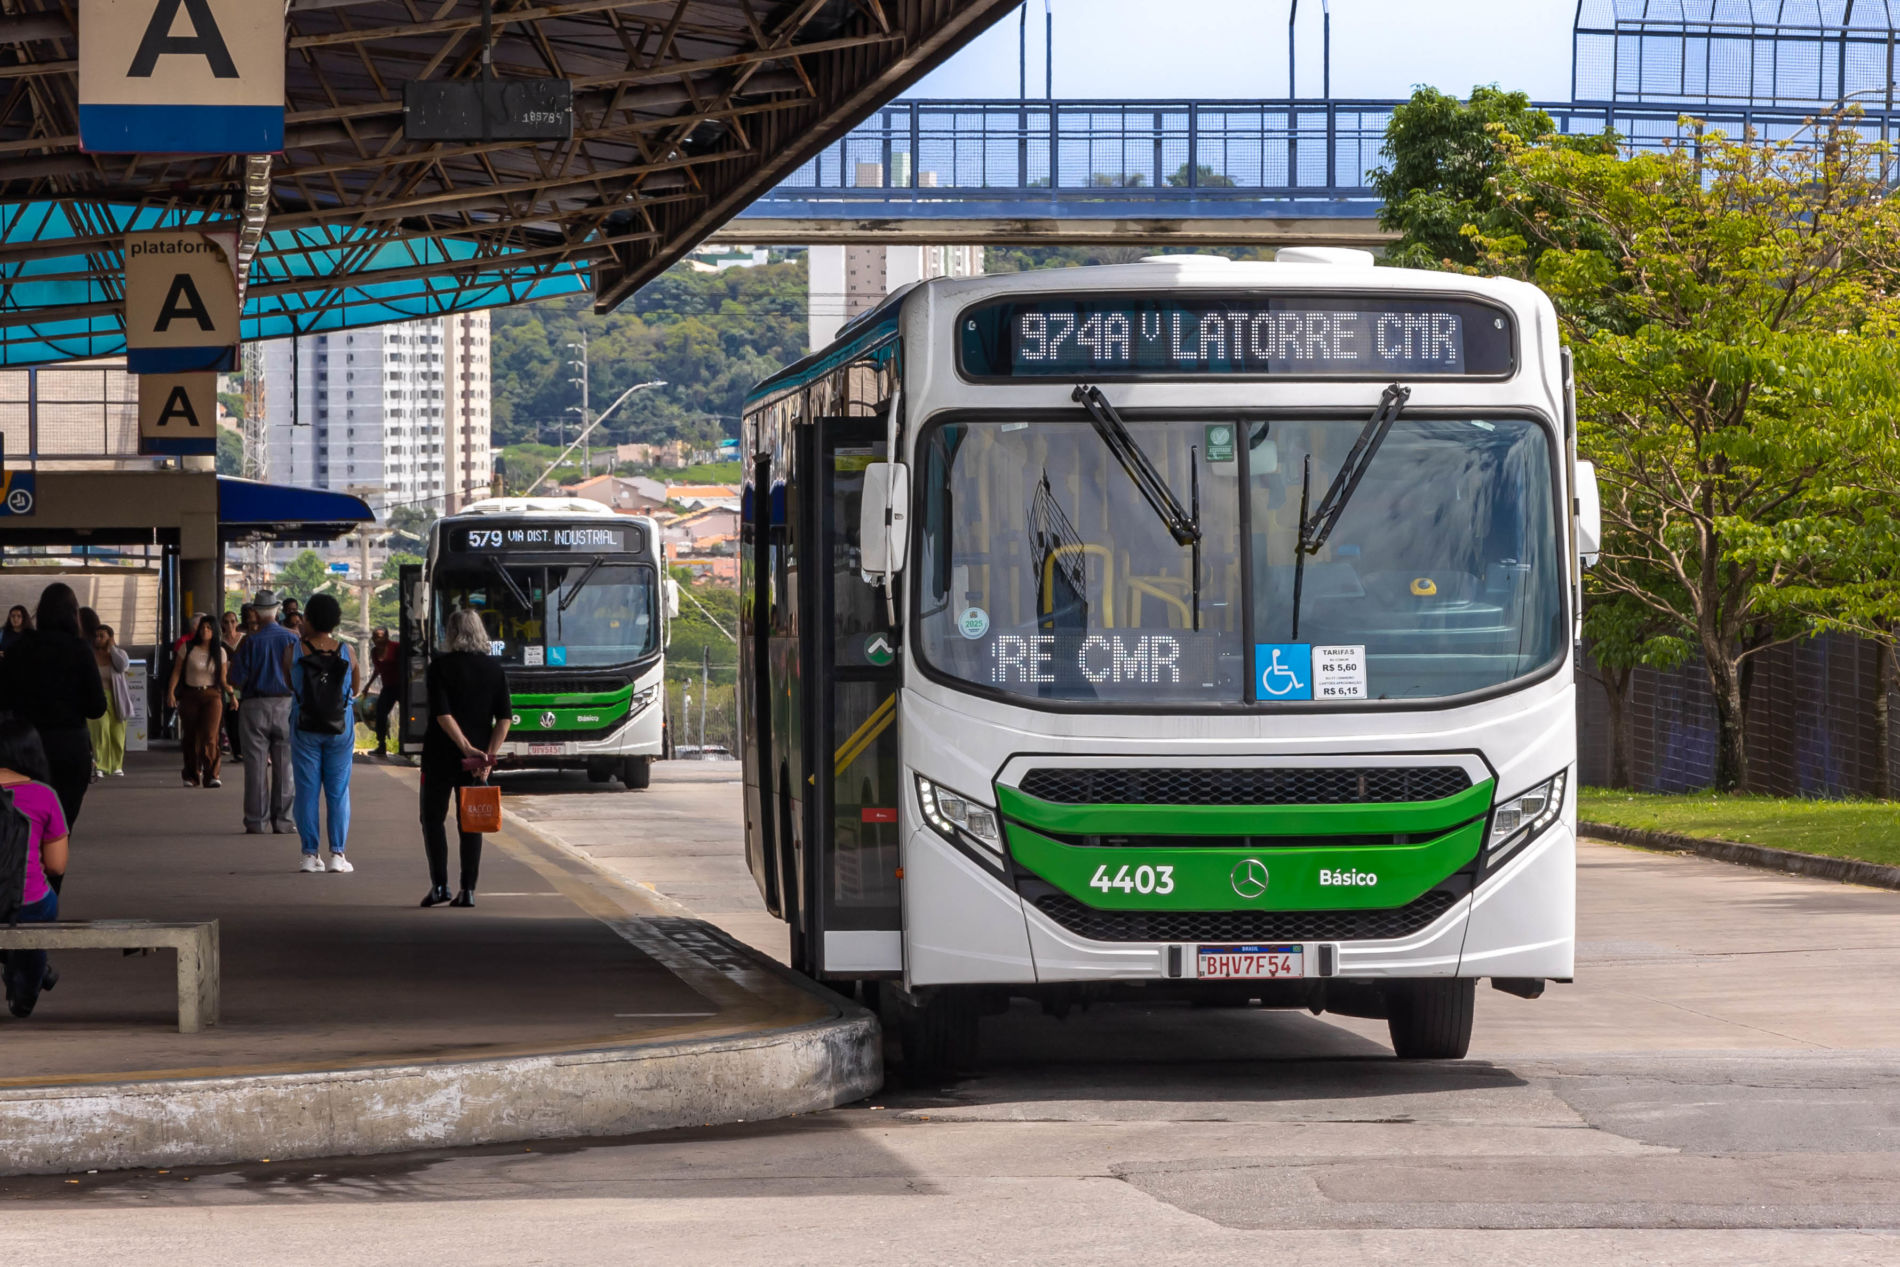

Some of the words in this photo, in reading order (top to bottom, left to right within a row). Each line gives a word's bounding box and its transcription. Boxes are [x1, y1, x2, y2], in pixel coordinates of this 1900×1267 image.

[127, 0, 240, 78] A
[153, 273, 216, 332] A
[1021, 312, 1129, 360] 974A
[1173, 312, 1358, 360] LATORRE
[1377, 312, 1457, 360] CMR
[156, 386, 200, 427] A
[468, 530, 503, 547] 579
[507, 530, 524, 542] VIA
[527, 530, 552, 542] DIST.
[554, 529, 617, 545] INDUSTRIAL
[965, 620, 983, 628] 2025
[1078, 635, 1181, 682] CMR
[1322, 664, 1335, 672] R$
[1337, 663, 1357, 672] 5,60
[1323, 687, 1336, 696] R$
[1338, 686, 1358, 696] 6,15
[1089, 865, 1175, 894] 4403
[1319, 868, 1378, 887] Básico
[1207, 955, 1292, 975] BHV7F54
